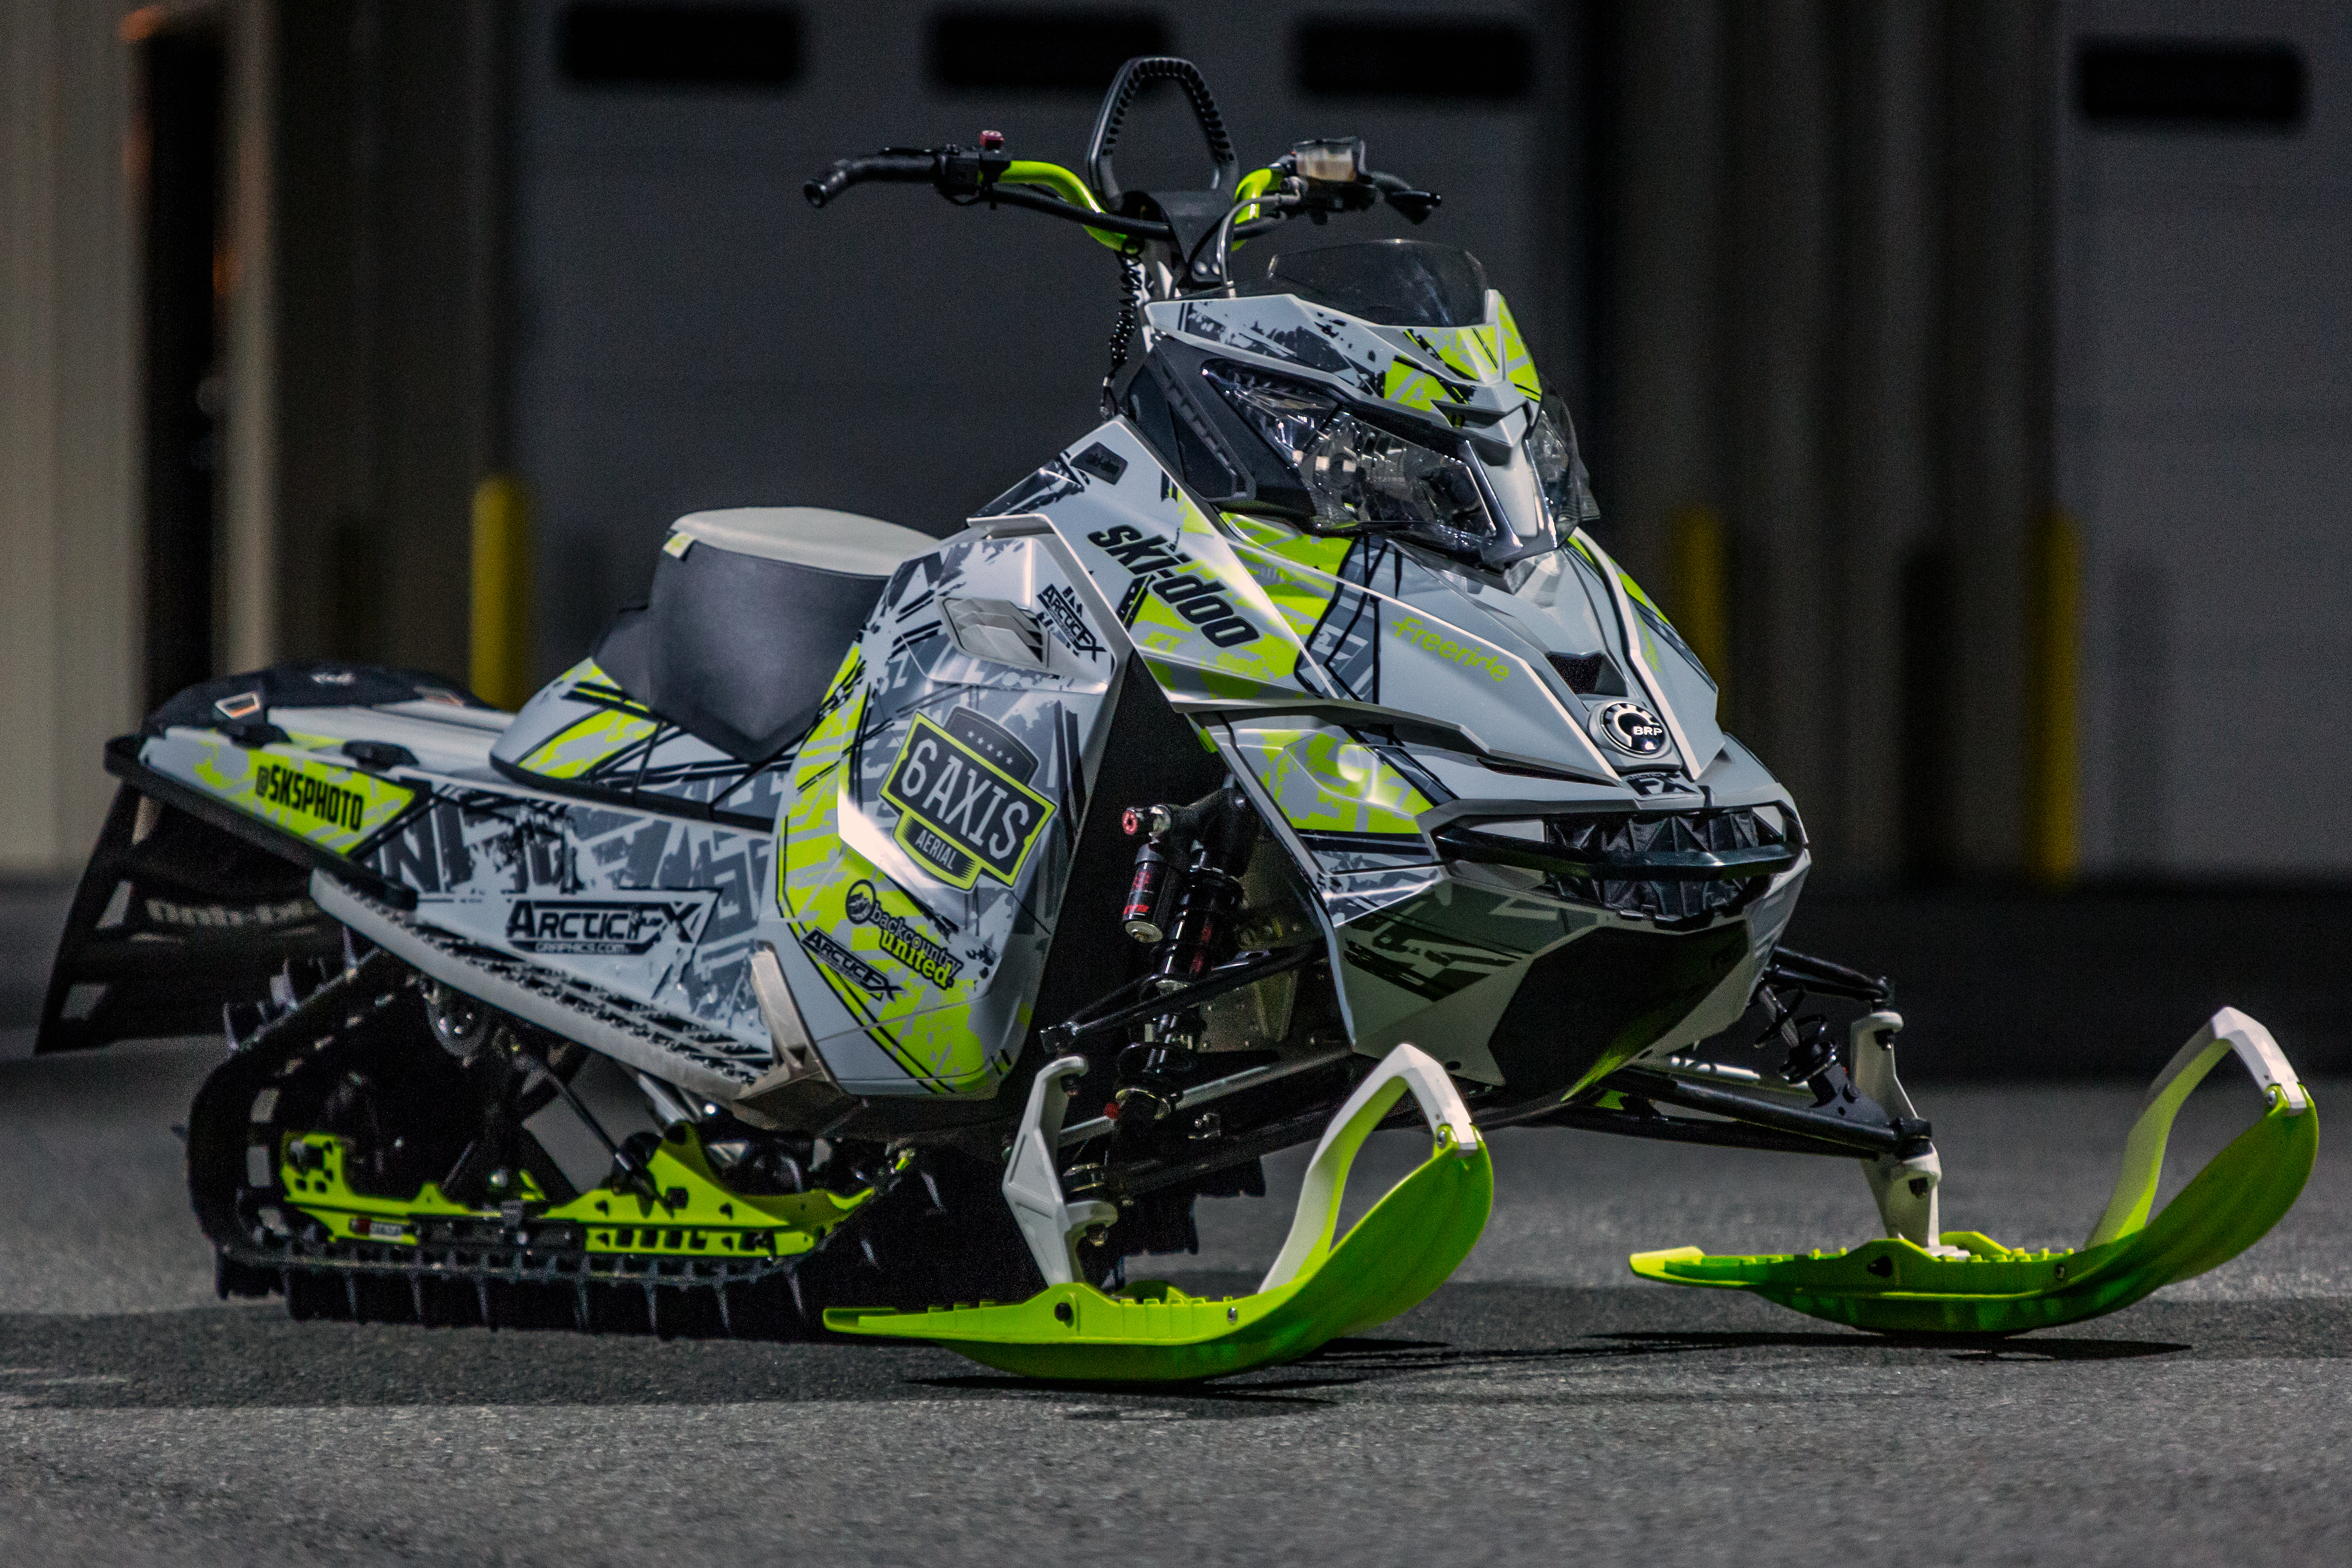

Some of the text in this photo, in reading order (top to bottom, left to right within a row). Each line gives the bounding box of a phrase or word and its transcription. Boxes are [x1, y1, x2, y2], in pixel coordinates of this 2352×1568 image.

[1633, 726, 1663, 736] BRP
[255, 764, 364, 832] @SKSPHOTO
[901, 738, 1029, 860] 6 AXIS
[915, 829, 957, 870] AERIAL
[869, 903, 962, 977] backcountry
[881, 930, 952, 987] united
